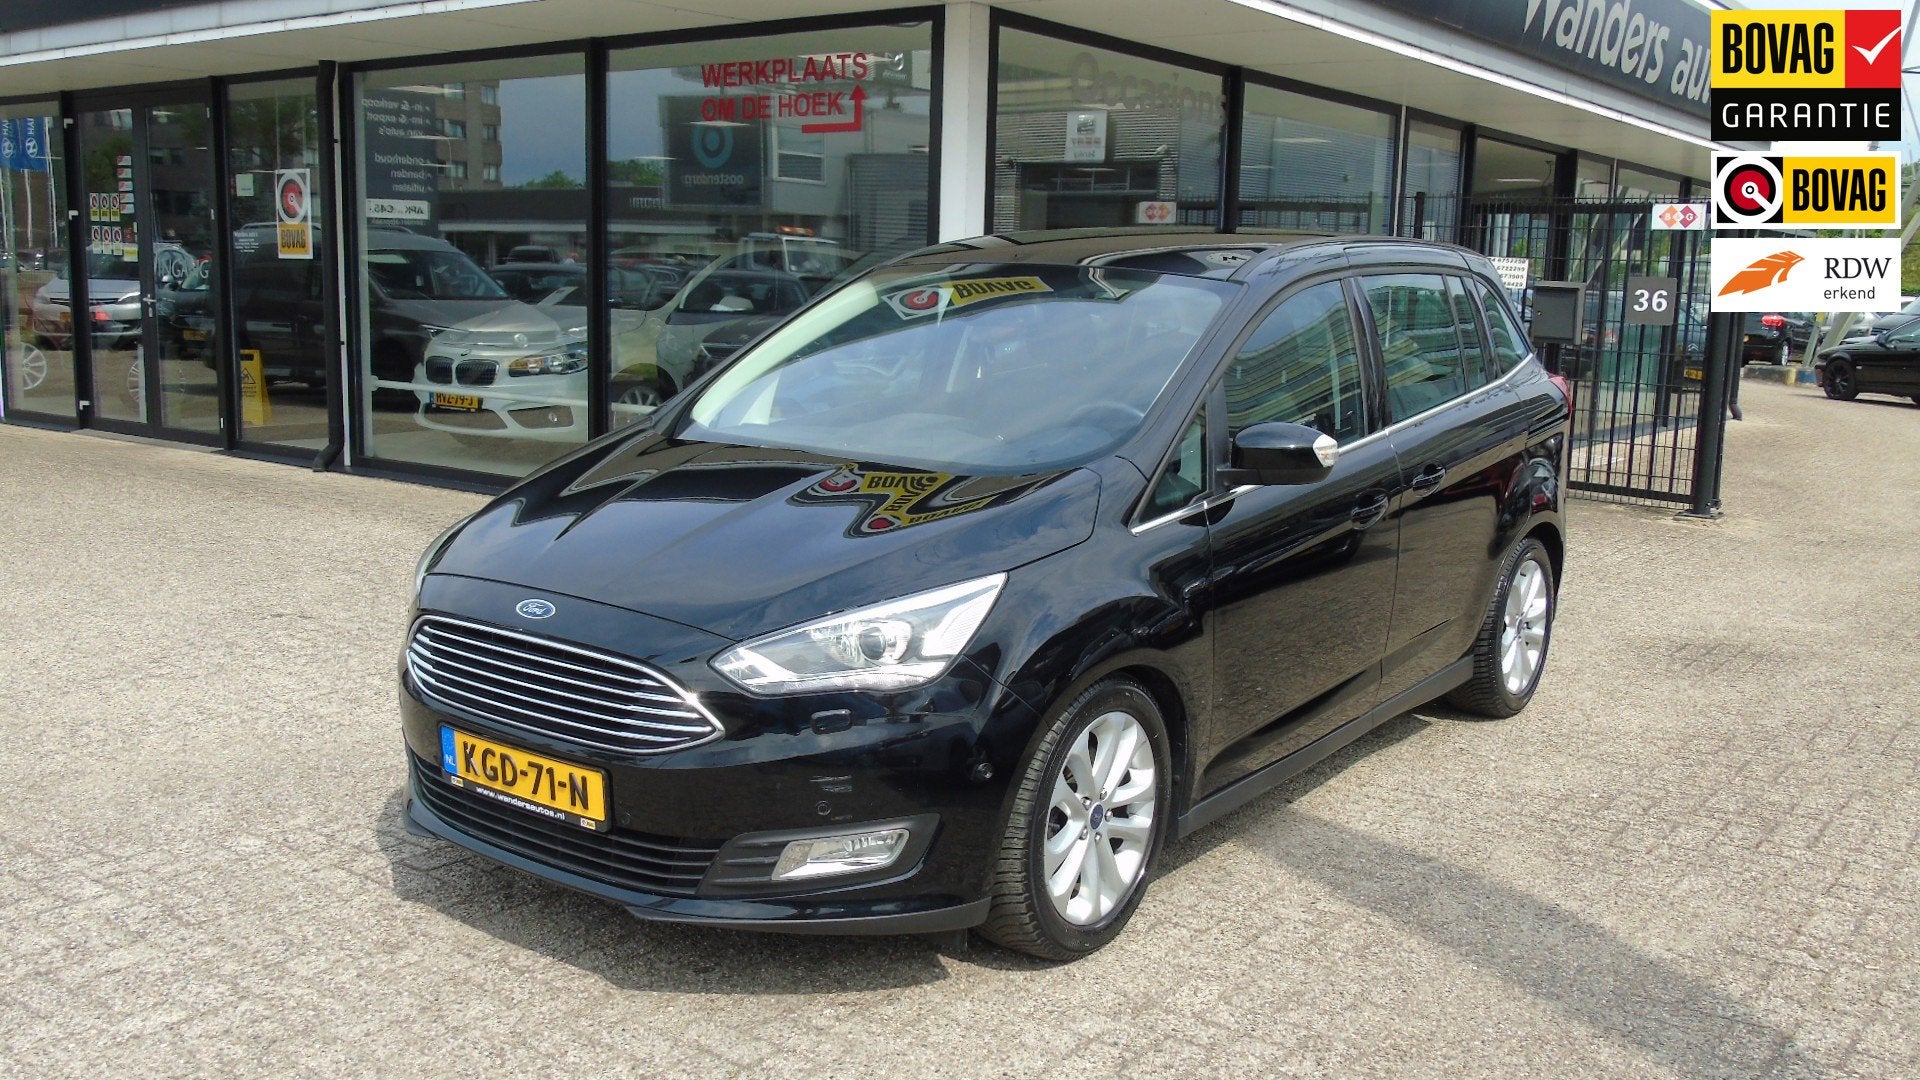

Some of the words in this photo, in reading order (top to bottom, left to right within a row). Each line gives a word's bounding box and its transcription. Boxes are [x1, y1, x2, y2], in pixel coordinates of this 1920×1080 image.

[701, 53, 868, 88] WERKPLAATS
[701, 97, 735, 121] OM
[743, 96, 771, 120] DE
[779, 91, 843, 117] HOEK
[1633, 289, 1668, 312] 36
[522, 602, 547, 615] Ford
[445, 754, 456, 766] NL
[463, 740, 589, 810] KGD-71-N
[475, 786, 566, 820] www.wandersautos.nl
